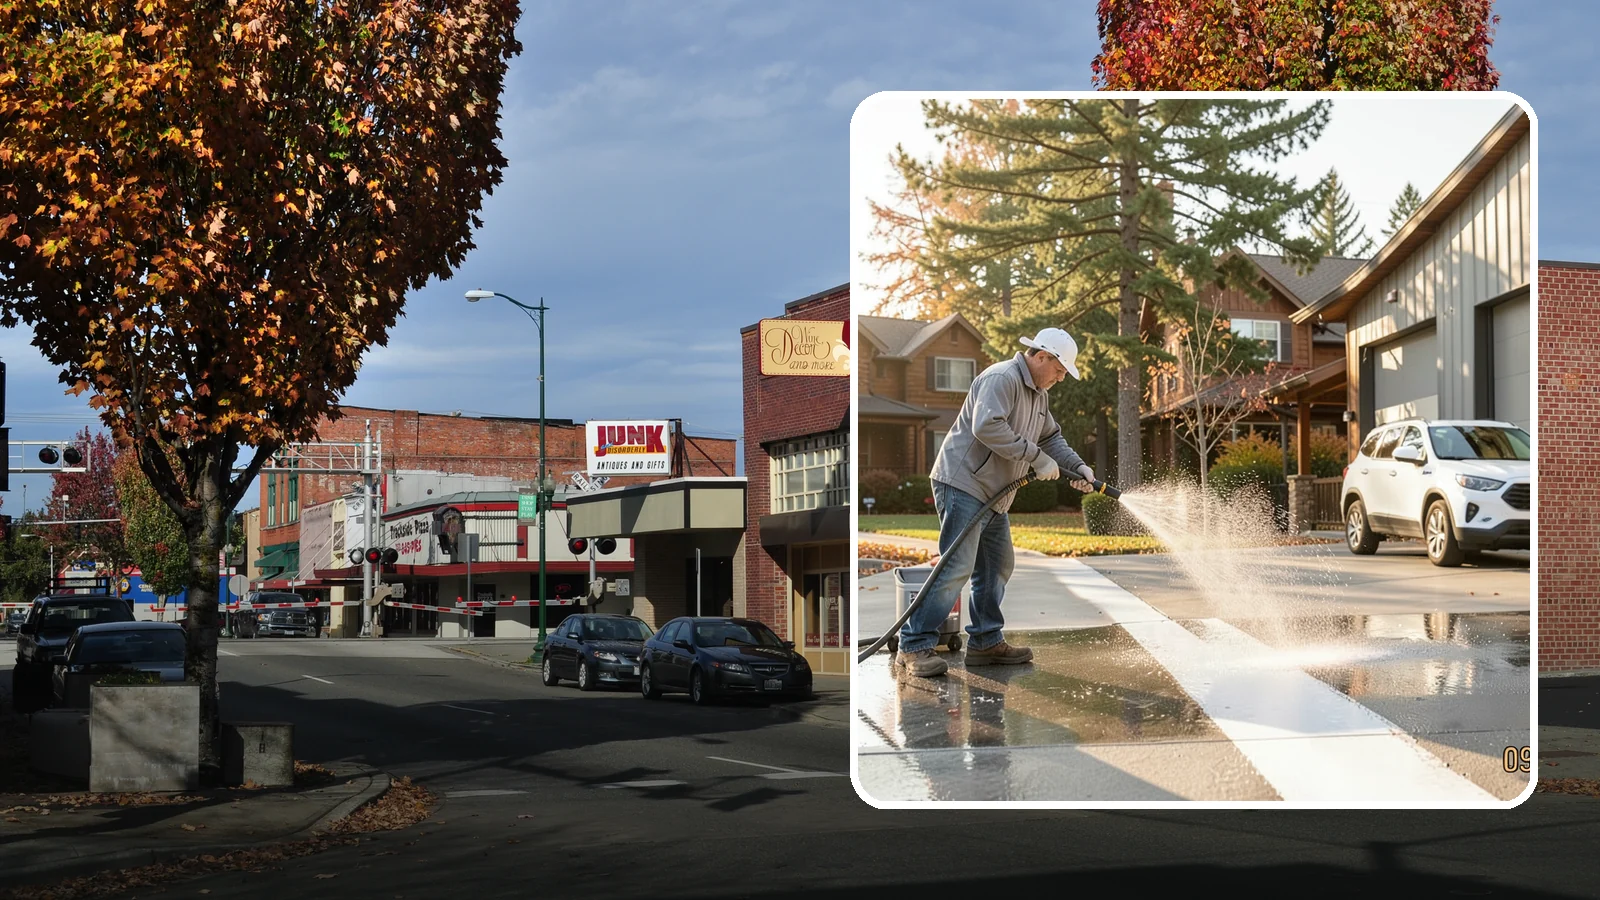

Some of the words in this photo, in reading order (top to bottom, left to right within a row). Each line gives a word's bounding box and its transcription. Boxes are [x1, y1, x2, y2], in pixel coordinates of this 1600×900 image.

[765, 328, 831, 365] Decor
[596, 425, 665, 457] JUNK
[608, 446, 645, 454] DISORDERLY
[597, 461, 628, 470] ANTIQUES
[631, 461, 643, 469] AND
[647, 461, 665, 469] GIFTS
[414, 519, 429, 535] Pizza
